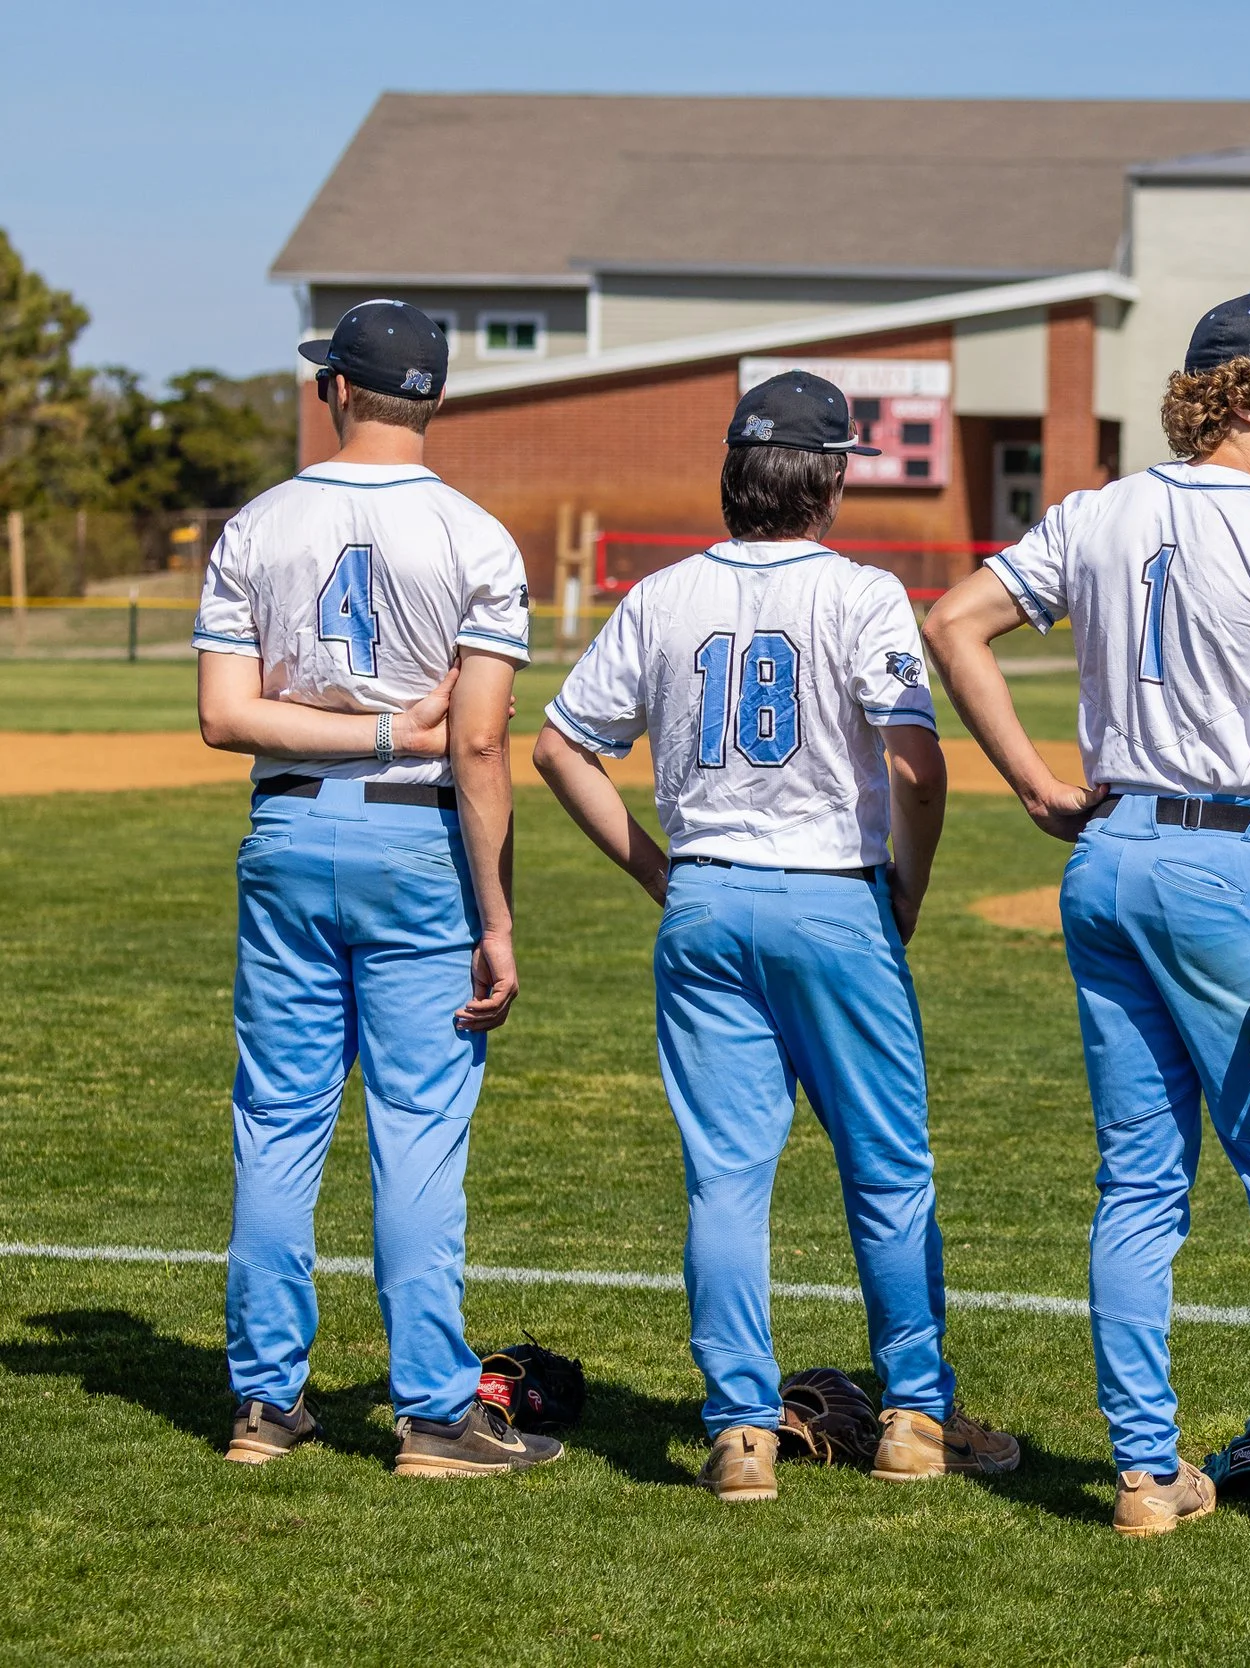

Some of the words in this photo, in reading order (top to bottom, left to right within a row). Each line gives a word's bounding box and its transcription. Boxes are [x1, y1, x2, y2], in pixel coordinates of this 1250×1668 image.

[317, 543, 380, 678] 4
[1139, 543, 1177, 685] 1
[694, 630, 802, 769] 18
[477, 1380, 509, 1393] awlings
